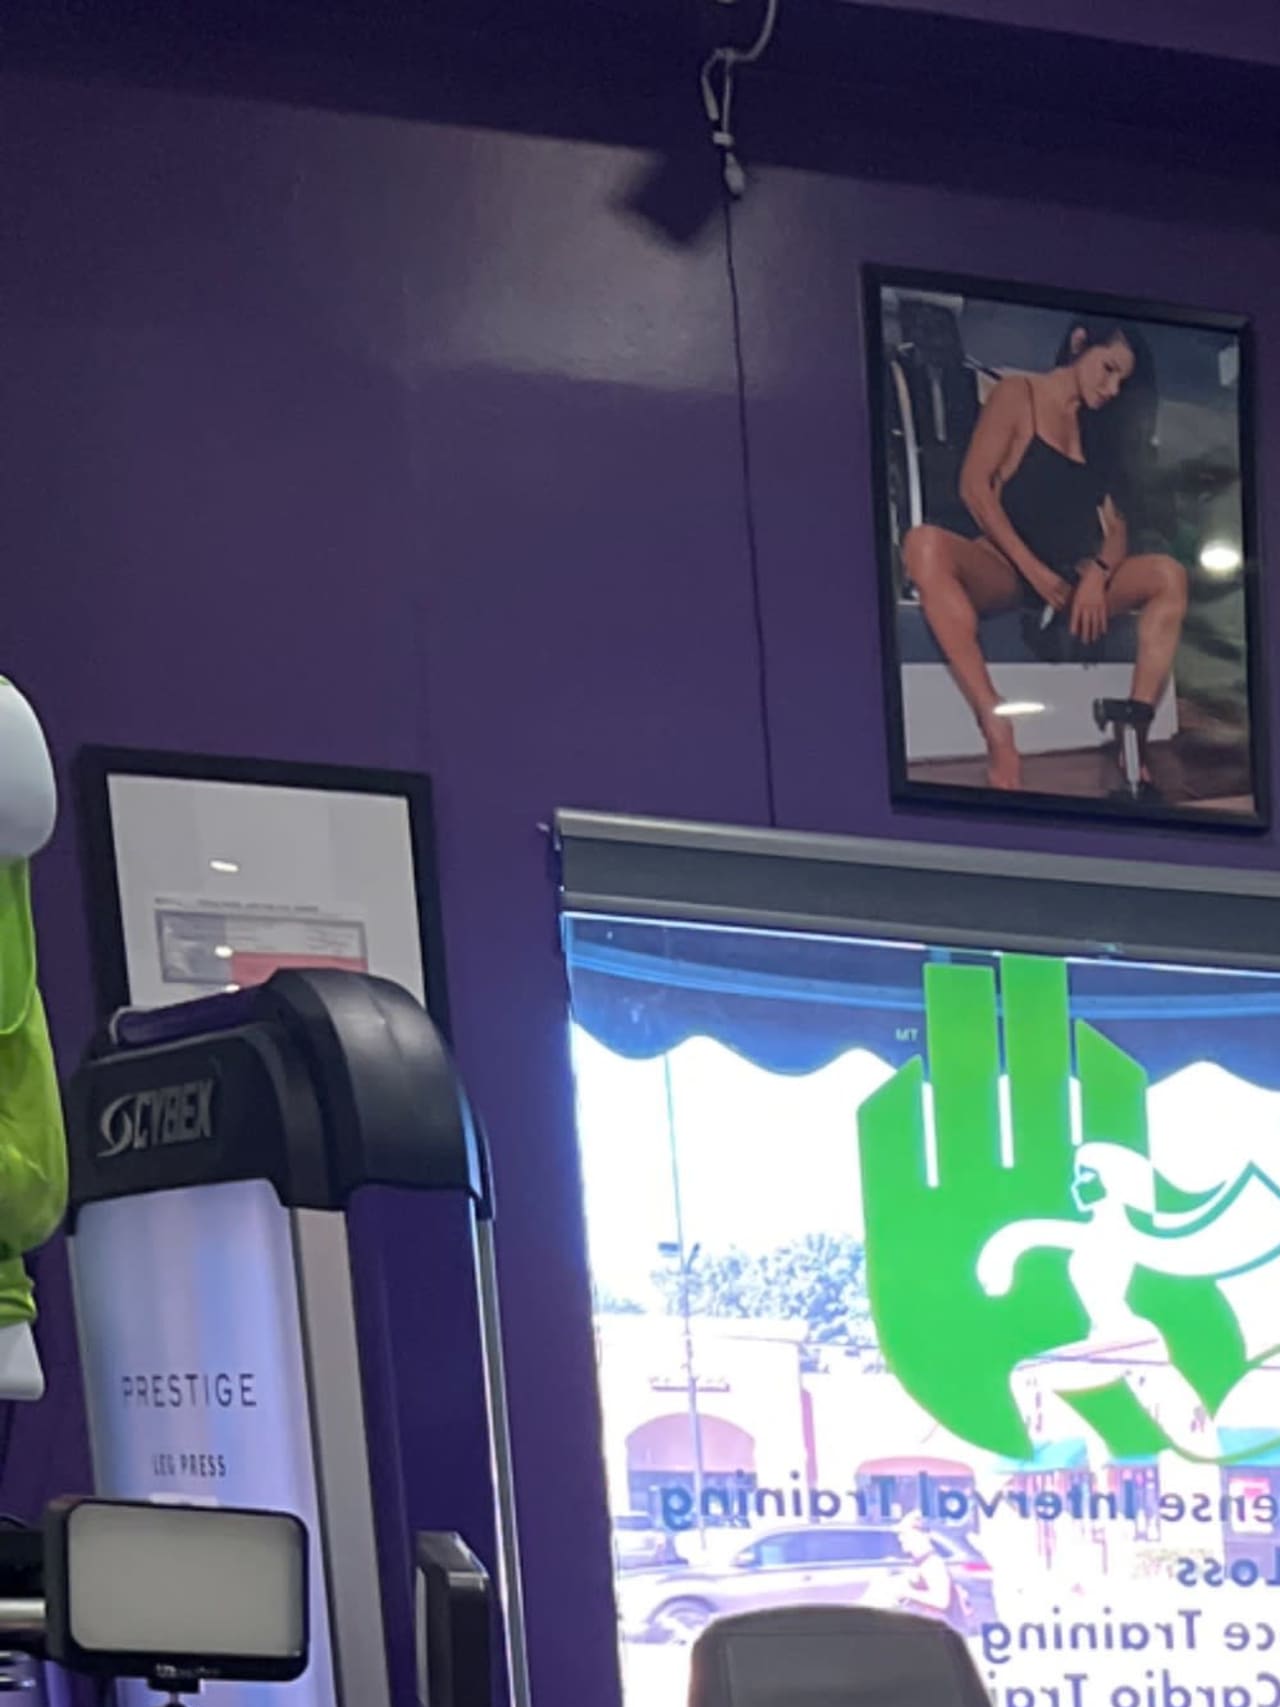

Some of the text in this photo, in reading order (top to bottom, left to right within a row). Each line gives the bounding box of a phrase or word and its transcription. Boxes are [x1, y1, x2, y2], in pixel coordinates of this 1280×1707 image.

[133, 1078, 213, 1150] CYBEX
[121, 1372, 257, 1408] PRESTIGE
[152, 1453, 226, 1477] LEG PRESS
